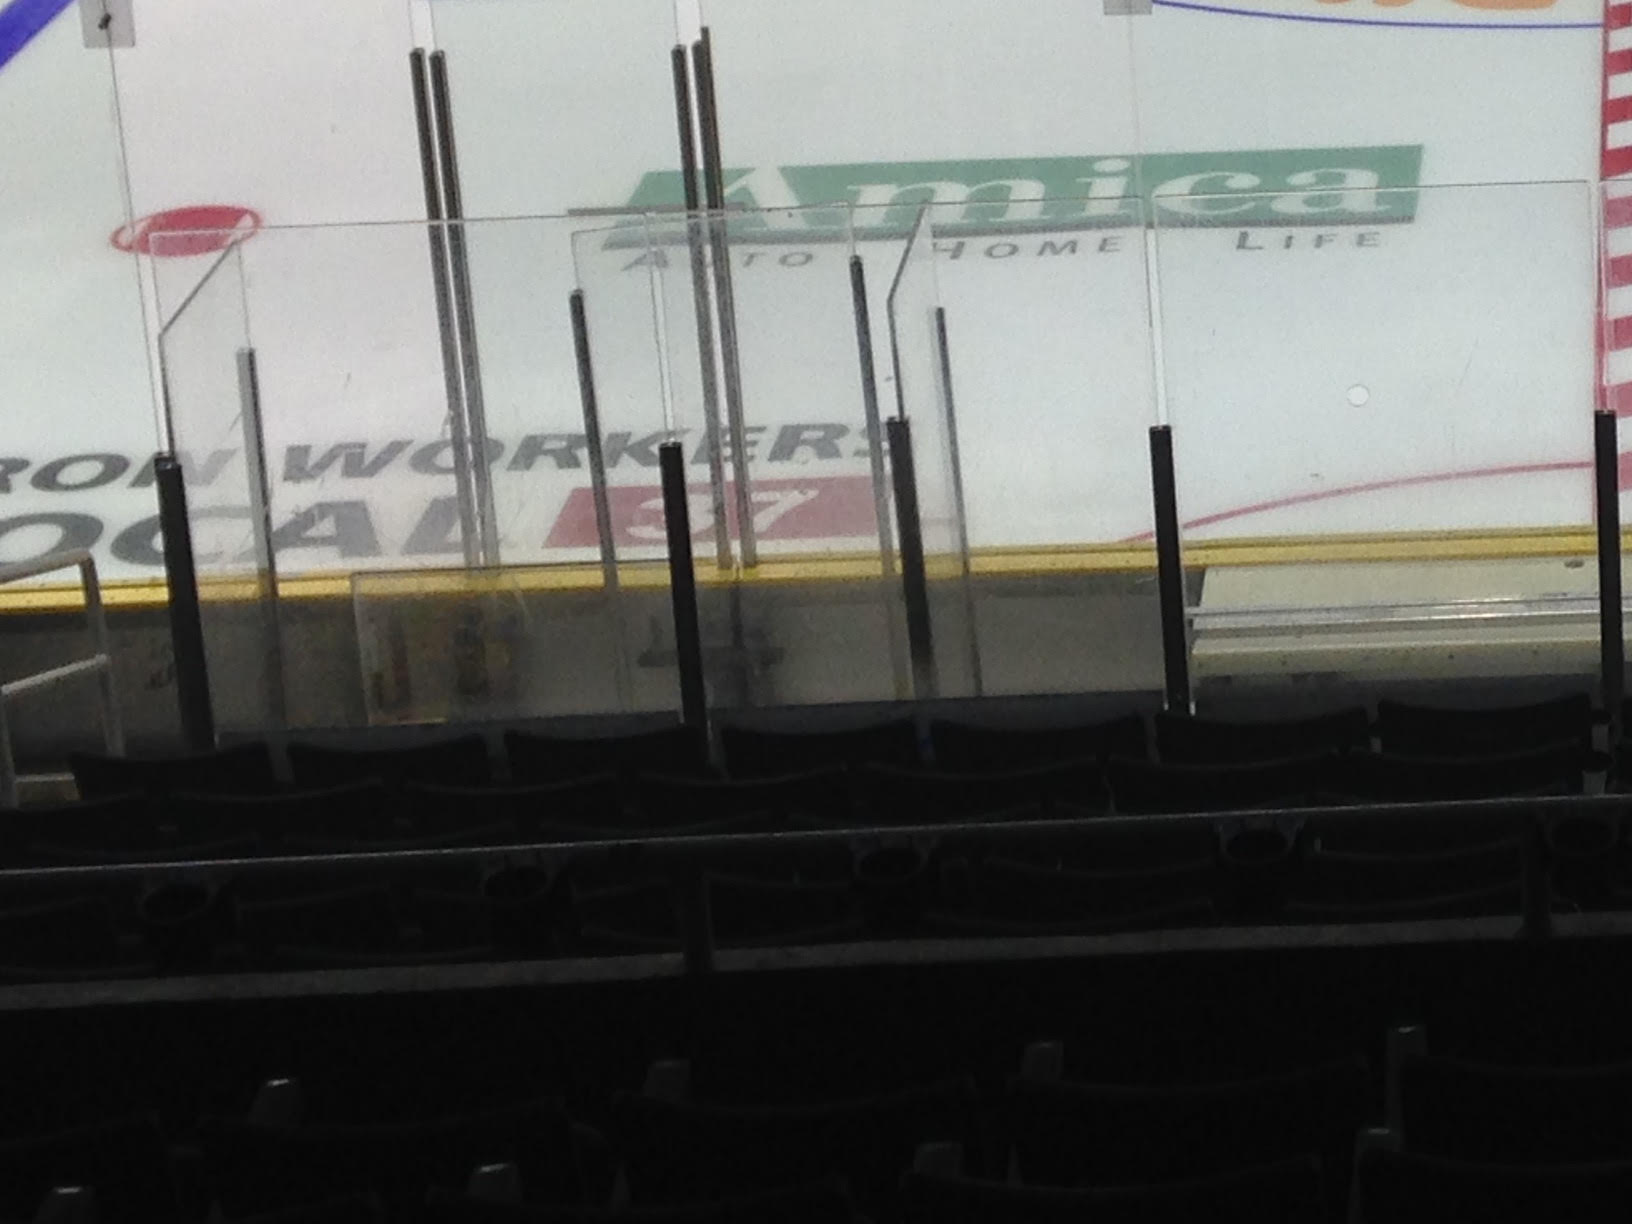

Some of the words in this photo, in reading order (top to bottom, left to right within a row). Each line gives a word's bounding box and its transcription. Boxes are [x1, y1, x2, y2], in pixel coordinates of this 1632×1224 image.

[690, 155, 1396, 232] Amica
[622, 249, 814, 272] ATO
[931, 234, 1124, 261] HOME
[1235, 229, 1383, 251] LIFE
